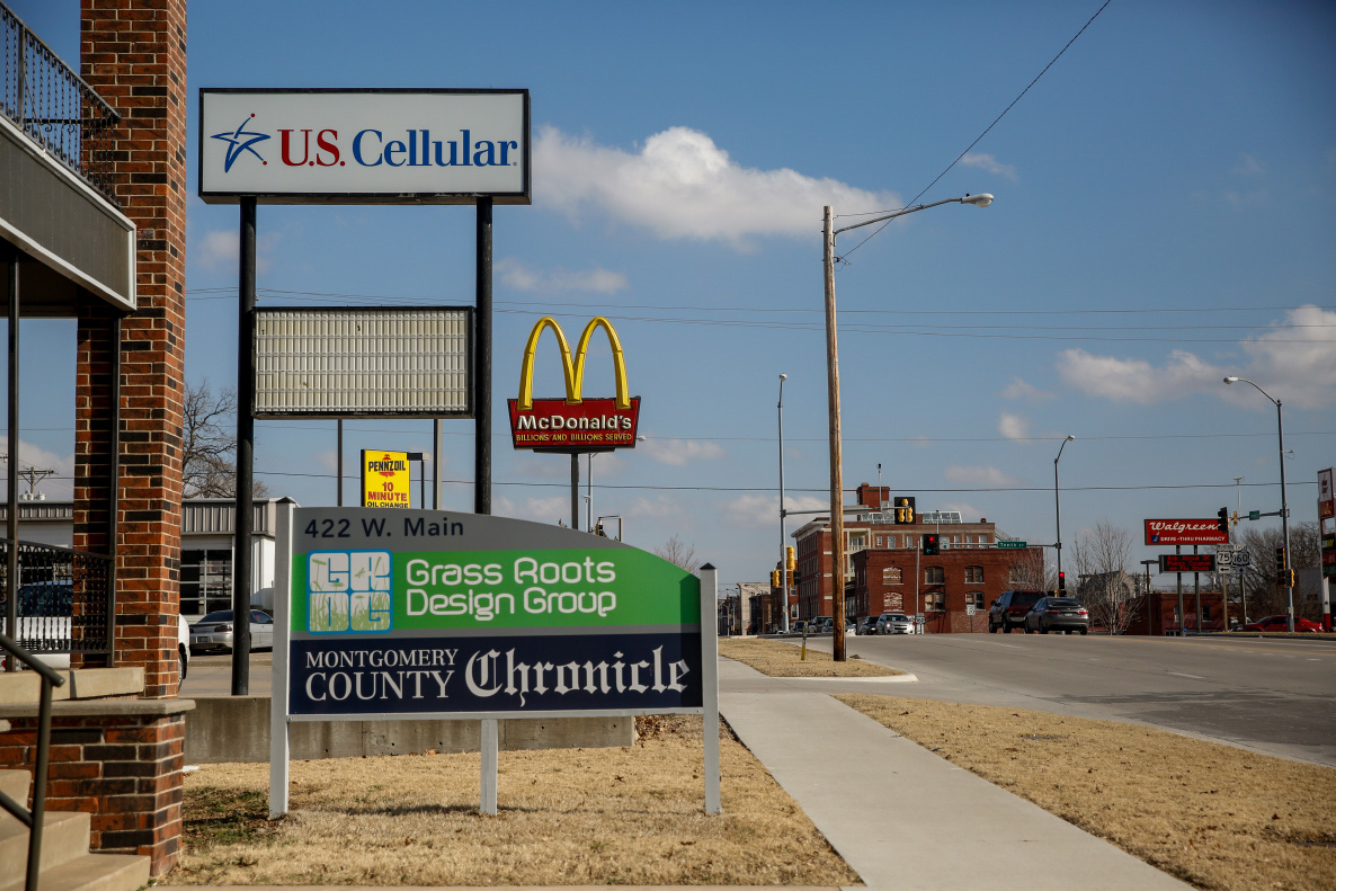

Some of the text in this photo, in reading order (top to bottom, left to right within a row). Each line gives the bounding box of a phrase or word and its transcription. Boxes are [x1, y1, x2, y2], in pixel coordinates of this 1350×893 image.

[277, 129, 518, 167] U.S. Cellular
[517, 414, 632, 431] McDonald's
[516, 434, 549, 442] BILLIONS
[605, 433, 632, 441] SERVED
[368, 460, 406, 472] PENNZOIL
[382, 481, 394, 492] 10
[368, 491, 407, 502] MINUTE
[304, 517, 464, 538] 422 W. Main
[1233, 553, 1248, 563] 160
[406, 556, 616, 586] Grass Roots
[406, 587, 617, 621] Design Group
[306, 648, 459, 668] MONTGOMERY
[305, 645, 691, 707] COUNTY Chronicle
